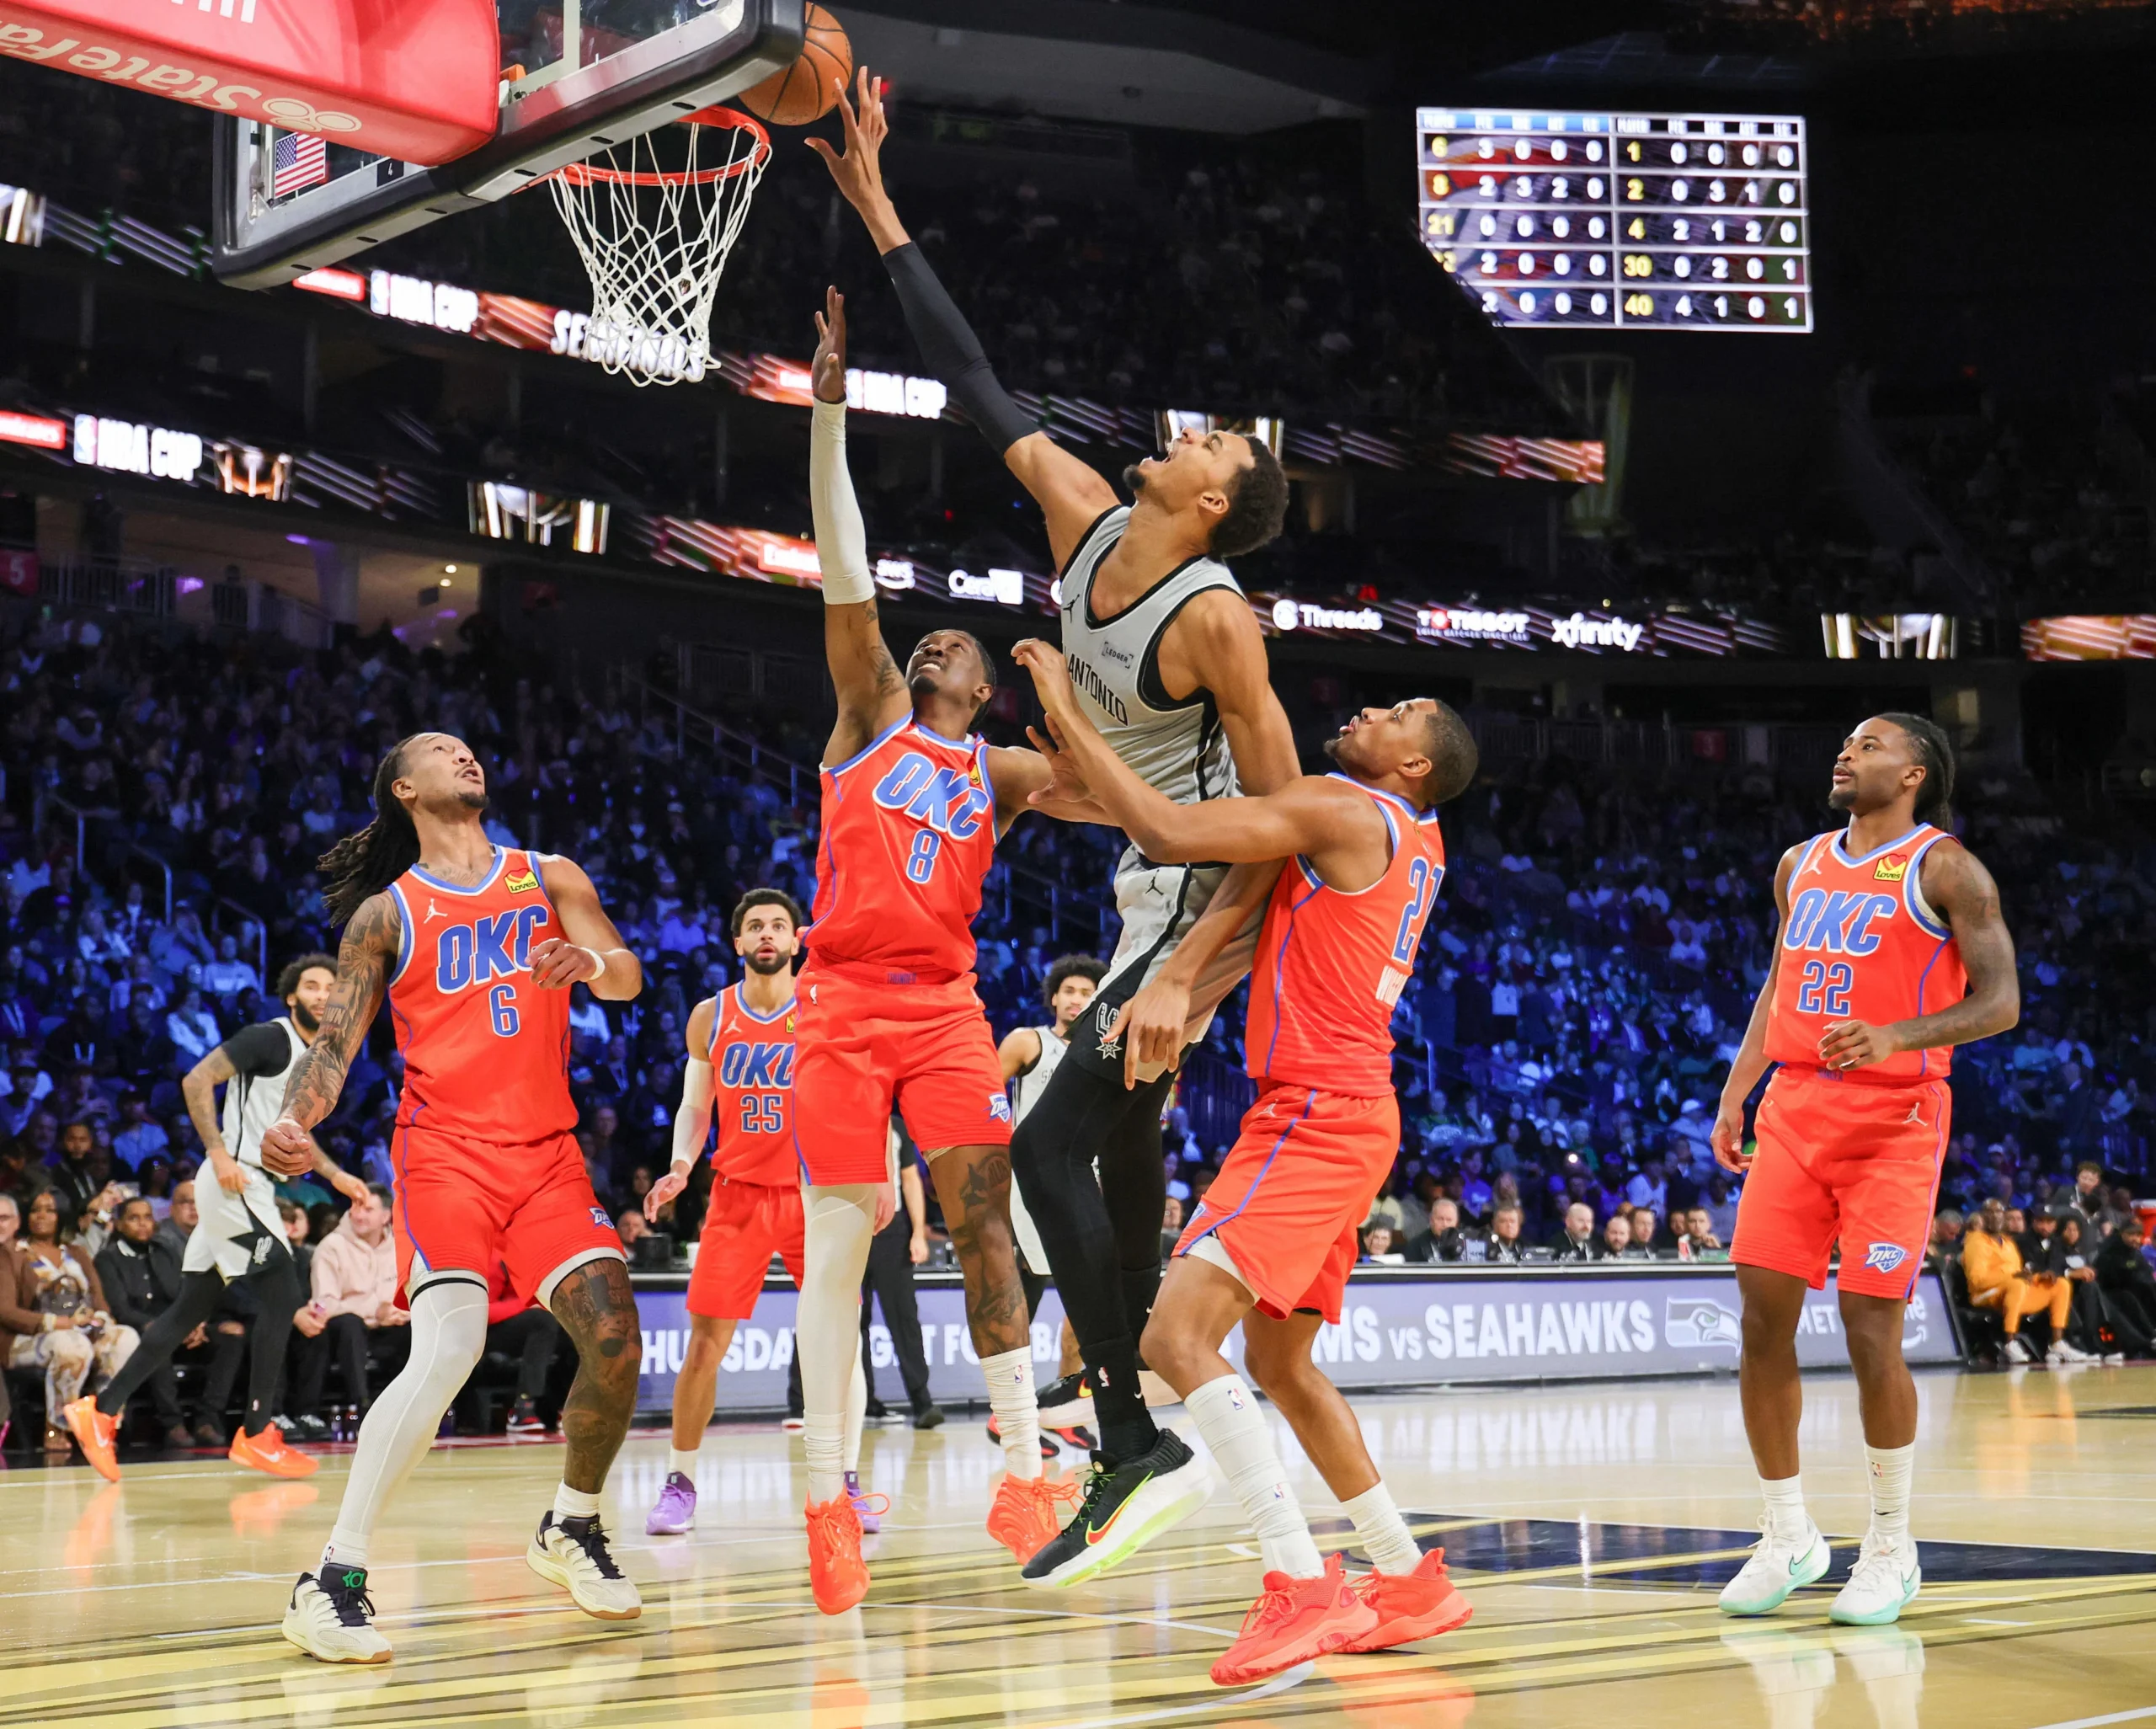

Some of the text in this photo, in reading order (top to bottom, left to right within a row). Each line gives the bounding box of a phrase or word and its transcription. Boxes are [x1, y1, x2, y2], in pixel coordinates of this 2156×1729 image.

[1431, 136, 1602, 162] 6 3 0 0 0
[1626, 141, 1793, 167] 1 0 0 0 0
[1433, 174, 1604, 199] 8 2 3 2 0
[1627, 179, 1795, 204] 2 0 3 1 0
[1428, 214, 1604, 238] 21 0 0 0 0
[1628, 218, 1796, 243] 4 2 1 2 0
[1481, 252, 1497, 274] 2
[1518, 253, 1534, 275] 0
[1554, 253, 1570, 275] 0
[1589, 254, 1605, 276] 0
[1624, 255, 1796, 280] 30 0 2 0 1
[1518, 292, 1535, 314] 0
[1555, 292, 1572, 314] 0
[1590, 294, 1607, 315] 0
[1624, 294, 1797, 319] 40 4 1 0 1
[1299, 603, 1384, 632] Threads
[1551, 611, 1642, 652] xfinity
[1104, 645, 1129, 664] LEDGER
[872, 752, 990, 840] OKC
[905, 828, 942, 884] 8
[1391, 856, 1446, 965] 21
[1782, 888, 1897, 957] OKC
[435, 905, 548, 995] OKC
[1796, 959, 1853, 1017] 22
[488, 984, 520, 1038] 6
[740, 1094, 783, 1134] 25
[1425, 1299, 1657, 1359] SEAHAWKS
[639, 1326, 796, 1375] HUSDA
